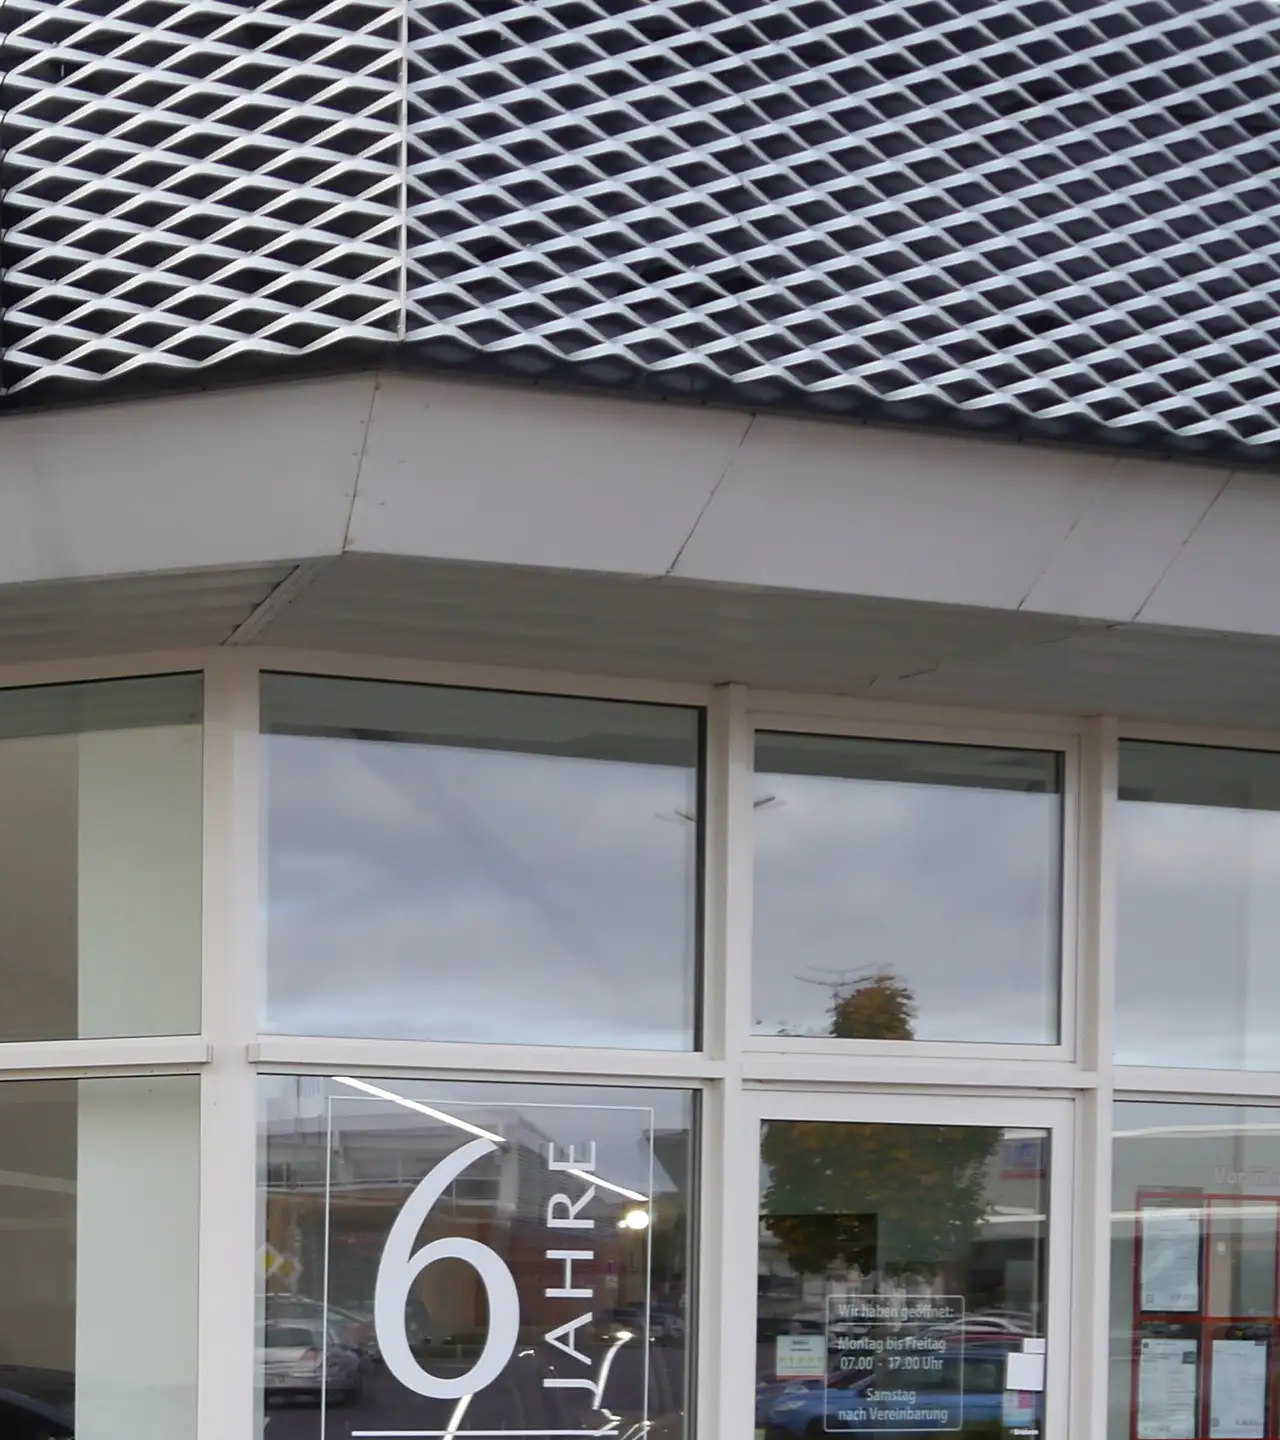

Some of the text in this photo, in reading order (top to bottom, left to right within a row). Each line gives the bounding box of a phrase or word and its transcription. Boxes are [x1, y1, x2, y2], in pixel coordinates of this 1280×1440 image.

[373, 1137, 521, 1400] 6
[542, 1139, 598, 1396] JAHRE
[838, 1303, 859, 1318] Wir
[861, 1303, 898, 1318] haben
[837, 1336, 947, 1353] Montag bis Freitag
[840, 1356, 873, 1370] 07.00
[922, 1356, 944, 1370] Uhr
[865, 1388, 916, 1404] Samstag
[838, 1406, 948, 1423] nach Vereinbarung
